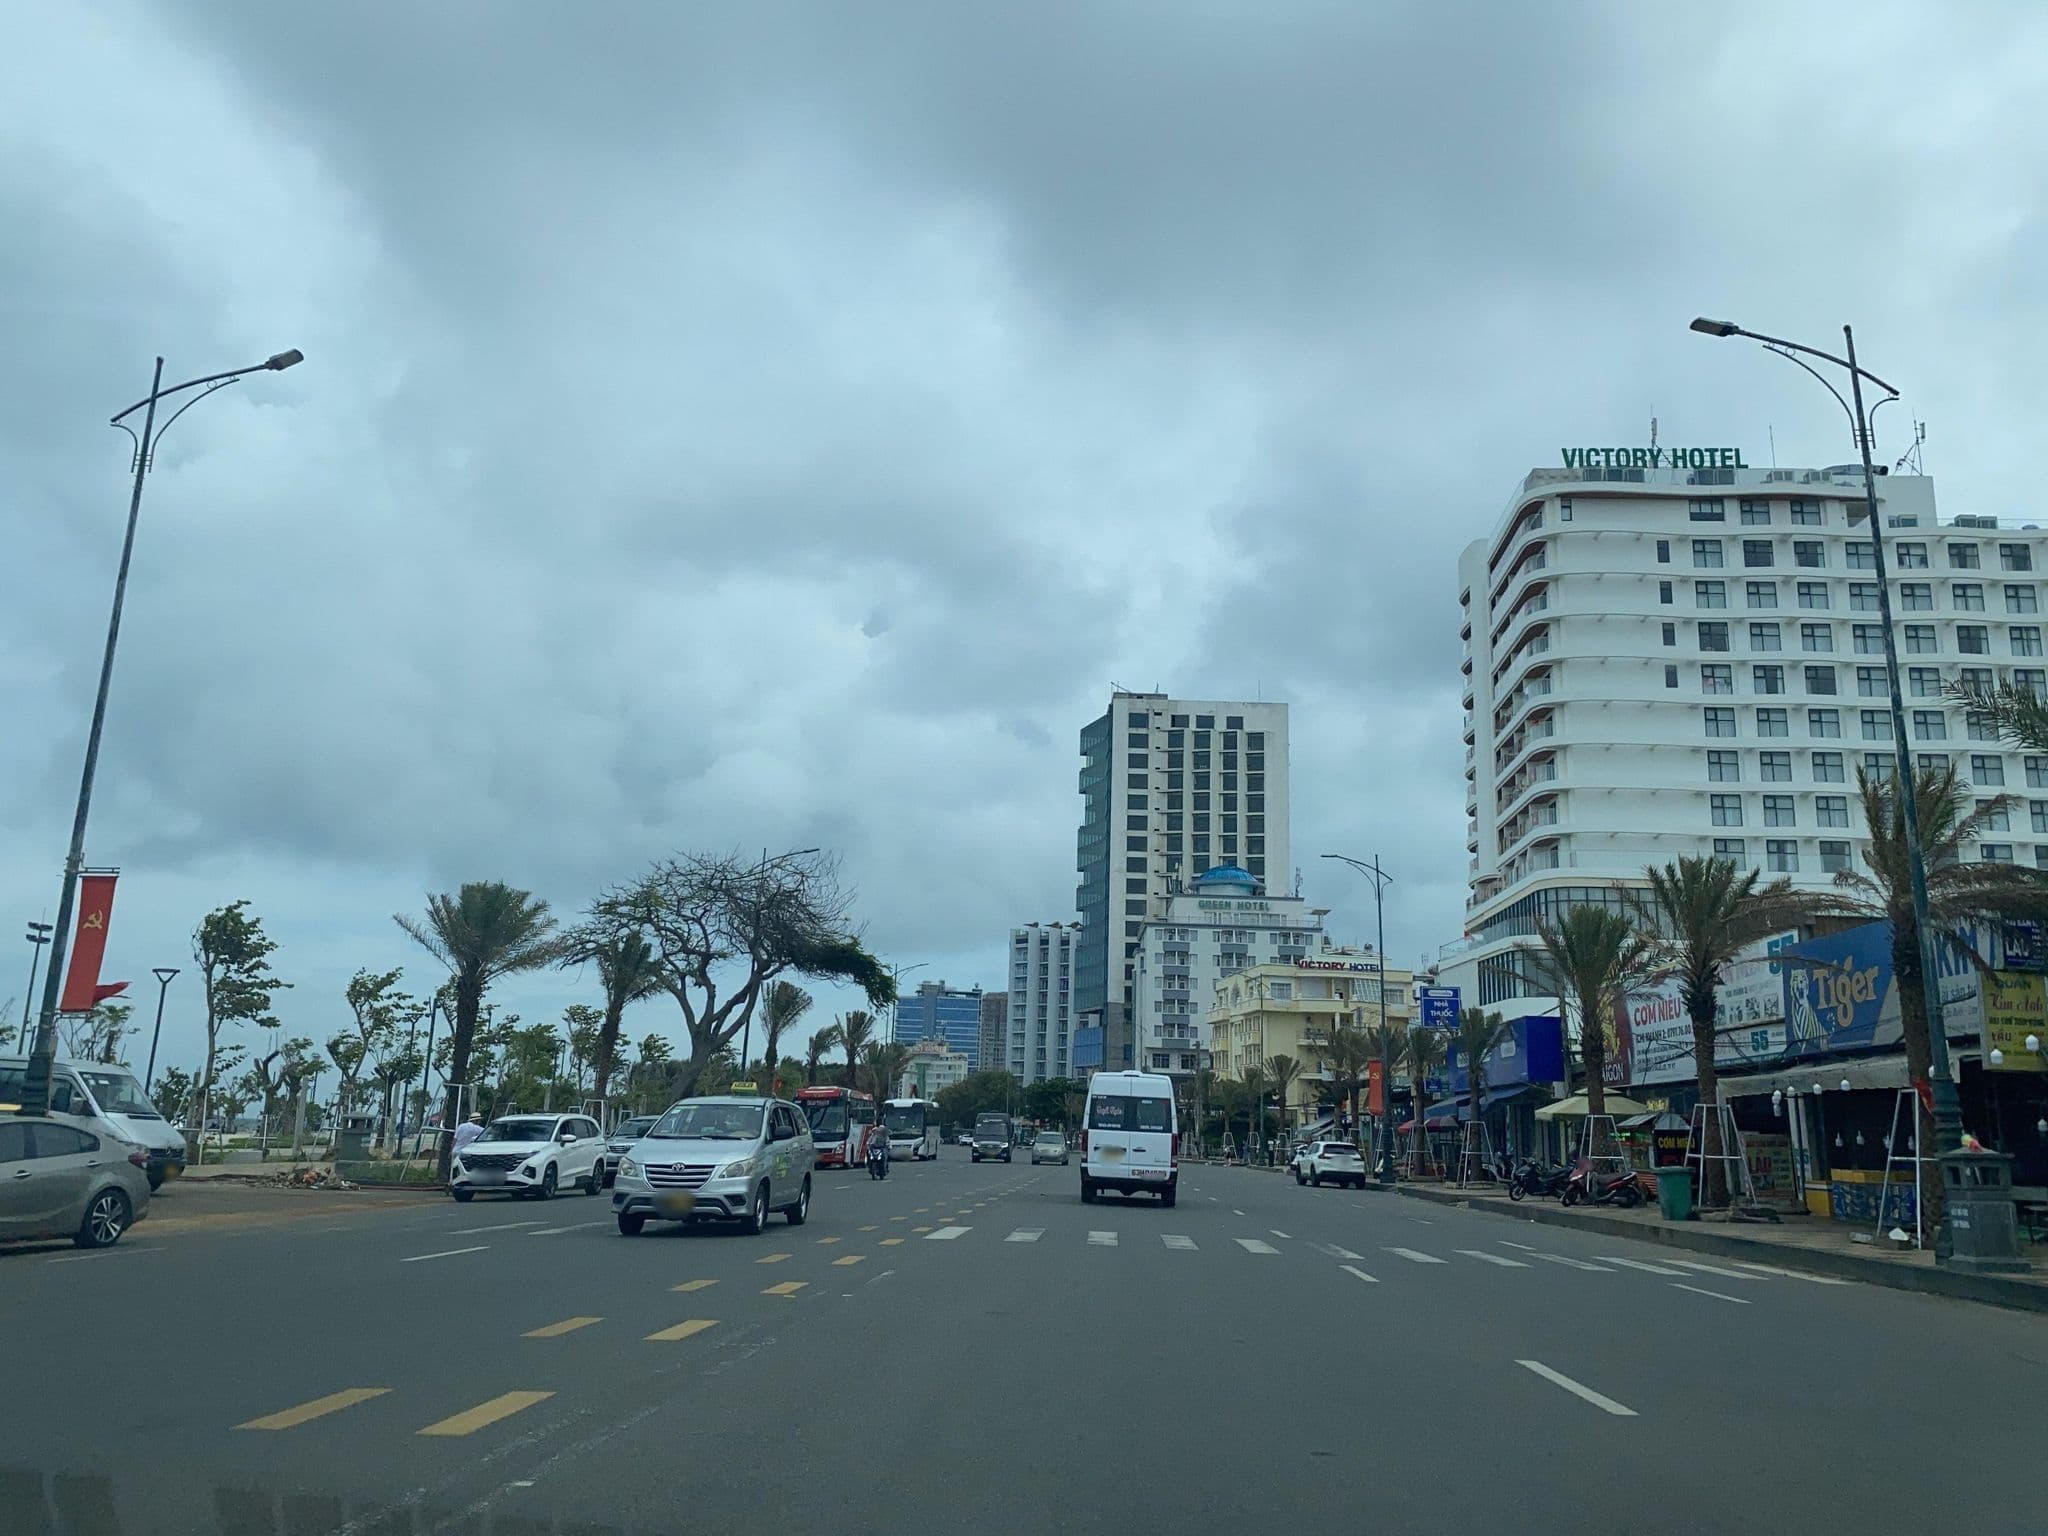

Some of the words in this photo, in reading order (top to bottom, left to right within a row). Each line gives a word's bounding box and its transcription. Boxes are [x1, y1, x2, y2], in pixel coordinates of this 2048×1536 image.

[1561, 447, 1662, 469] VICTORY
[1671, 447, 1749, 469] HOTEL
[1198, 899, 1232, 911] GREEN
[1236, 901, 1271, 912] HOTEL
[1296, 959, 1345, 971] VICTORY
[1349, 962, 1381, 973] HOTEL
[1812, 955, 1879, 1027] Tiger
[1750, 1029, 1769, 1052] 55
